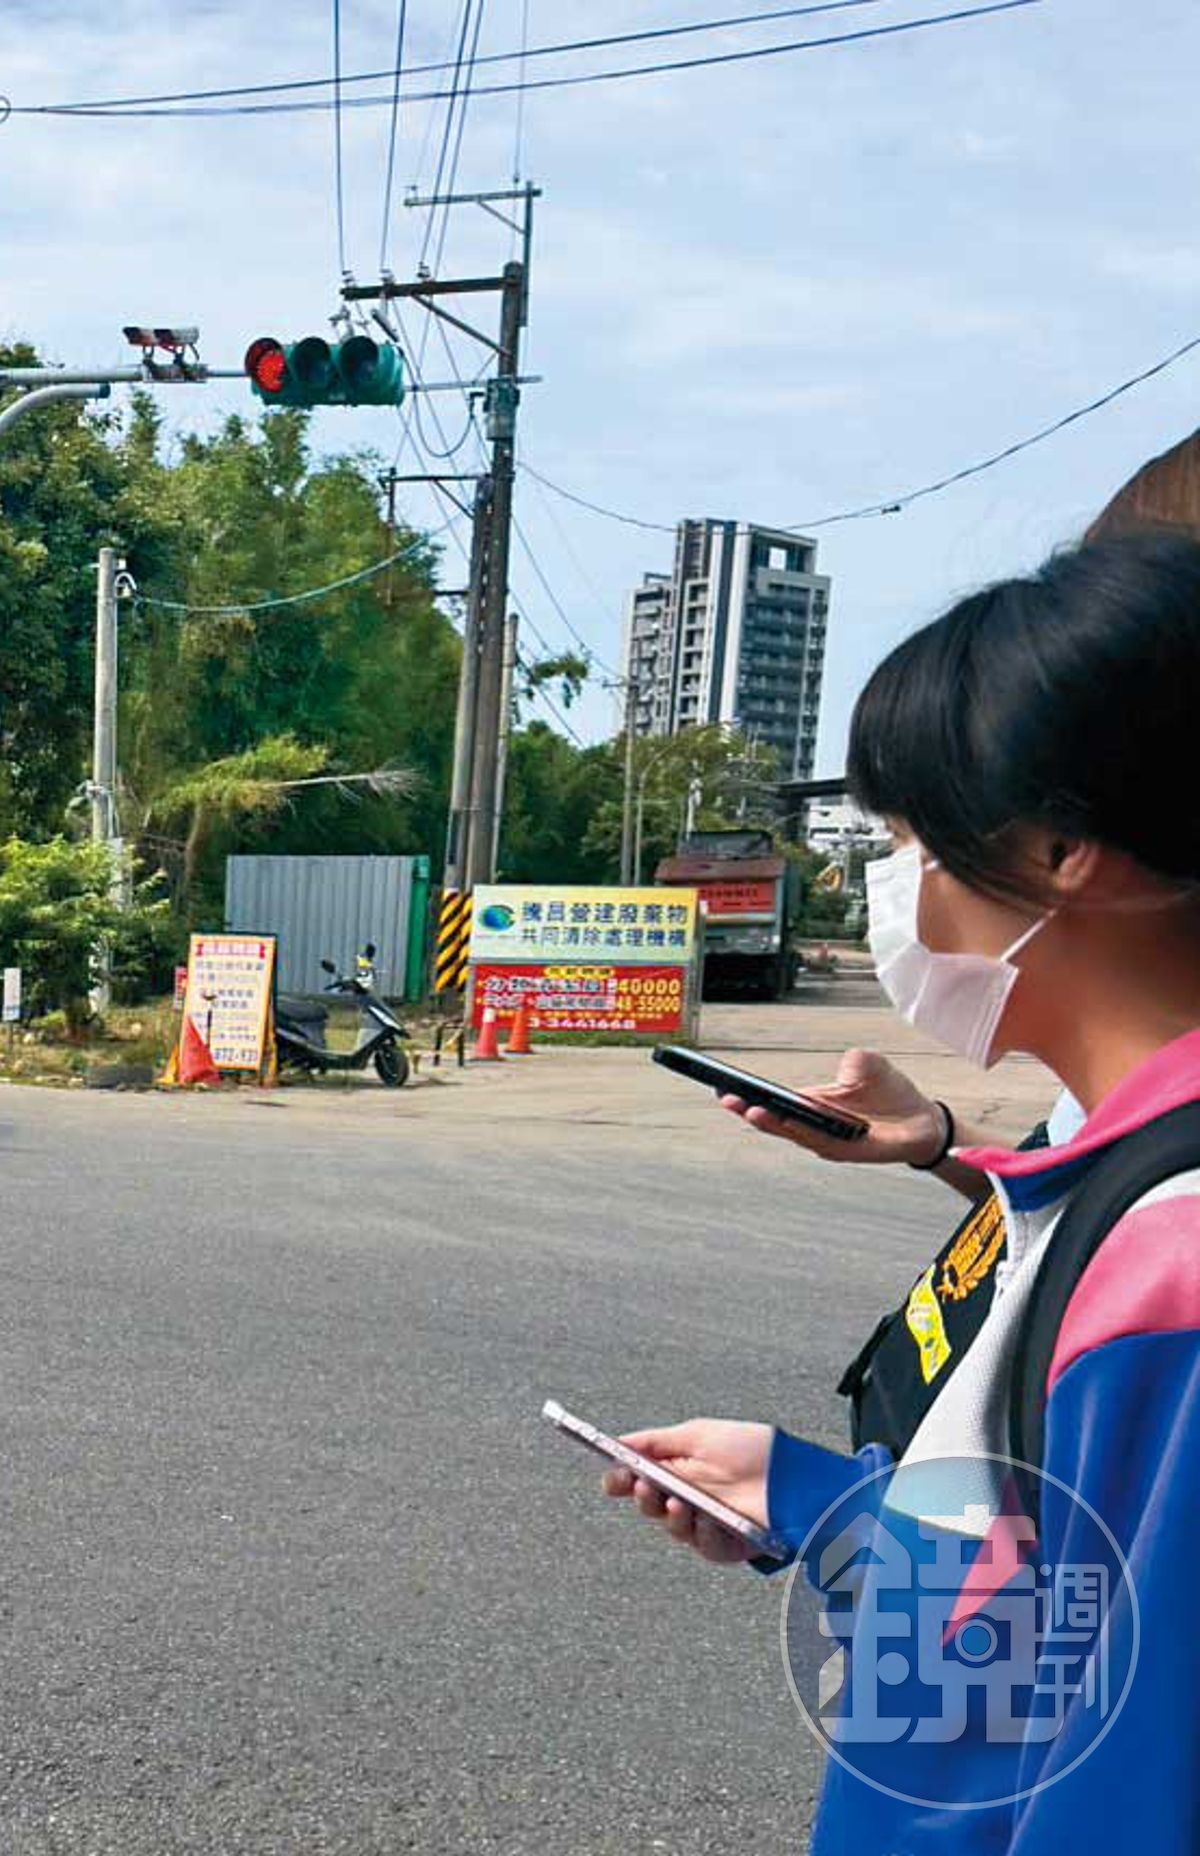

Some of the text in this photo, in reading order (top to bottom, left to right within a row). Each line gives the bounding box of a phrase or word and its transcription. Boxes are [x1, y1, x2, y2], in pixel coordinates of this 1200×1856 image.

[522, 926, 687, 947] 共同清除處理機構
